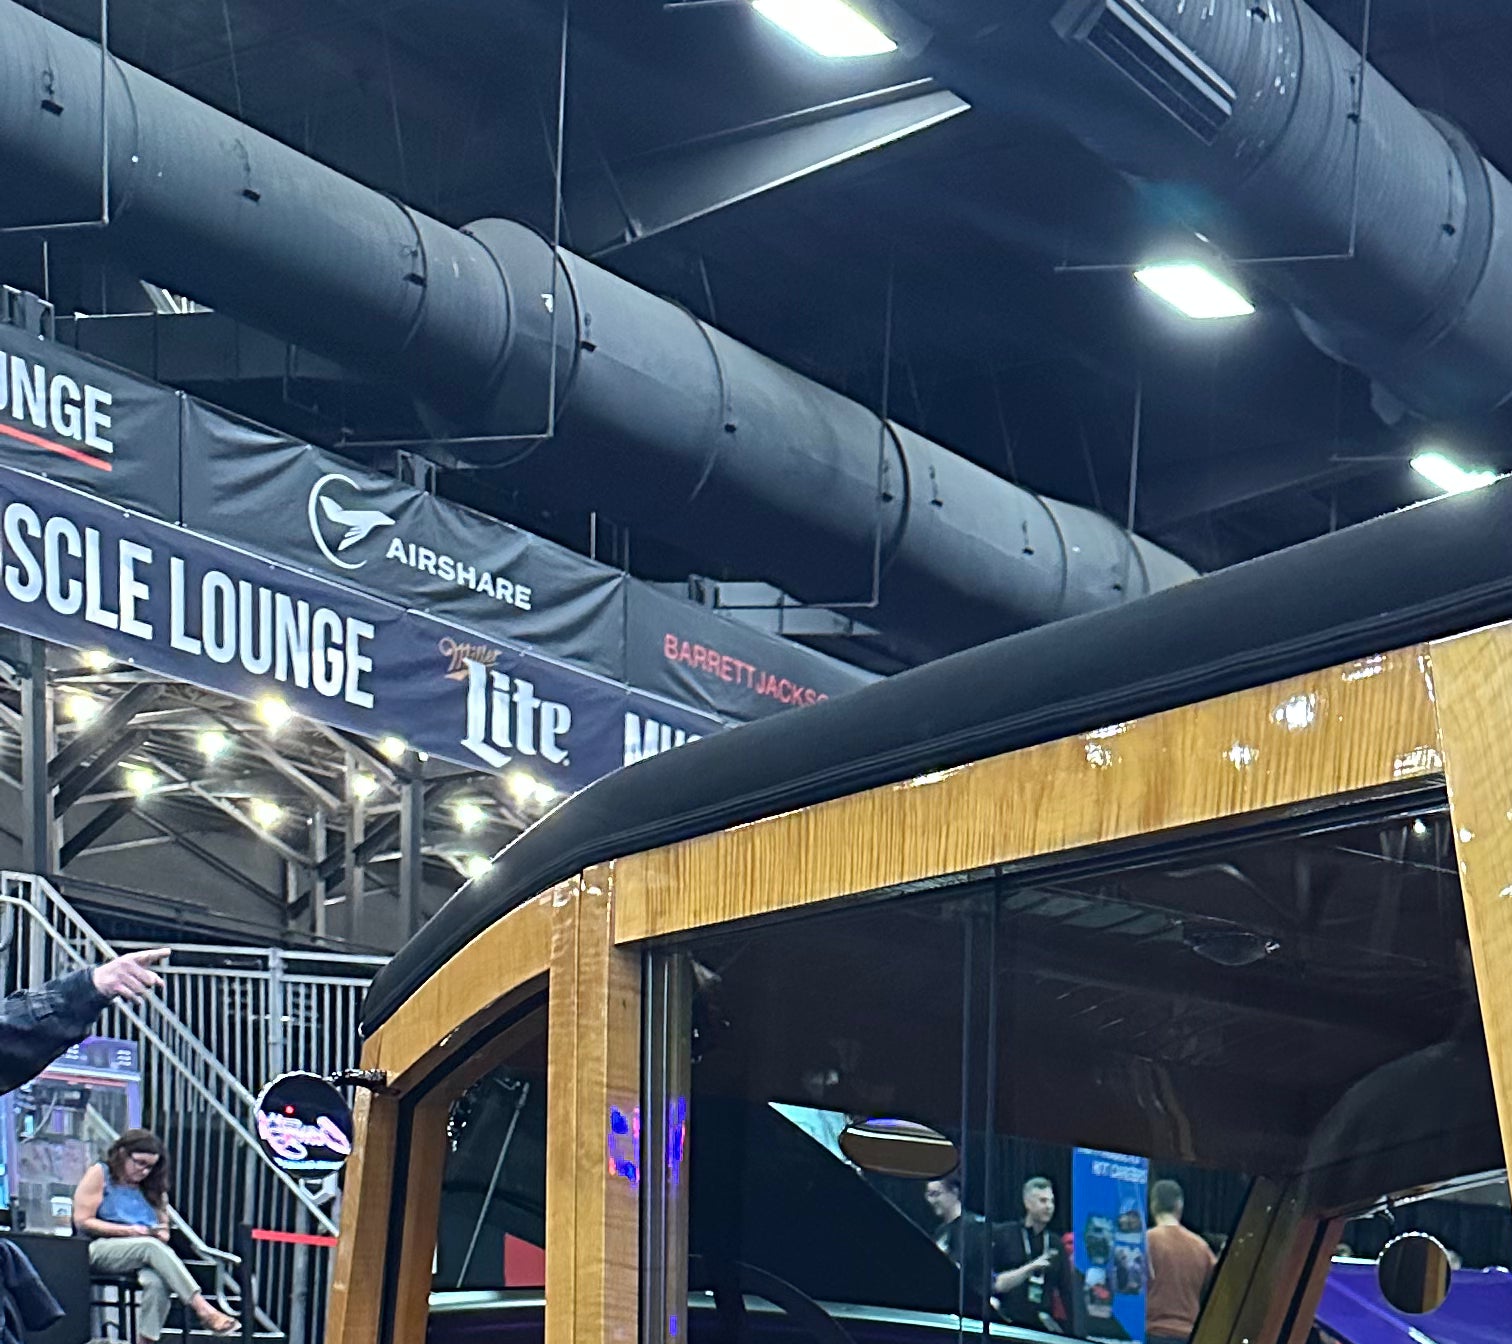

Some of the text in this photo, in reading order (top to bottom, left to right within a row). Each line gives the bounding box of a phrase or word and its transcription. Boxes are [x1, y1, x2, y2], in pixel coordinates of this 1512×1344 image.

[0, 355, 114, 454] NGE
[386, 537, 533, 611] AIRSHARE
[170, 556, 375, 710] LOUNGE
[438, 636, 503, 673] Miller
[663, 633, 756, 689] BARRETT
[460, 656, 572, 768] Lite
